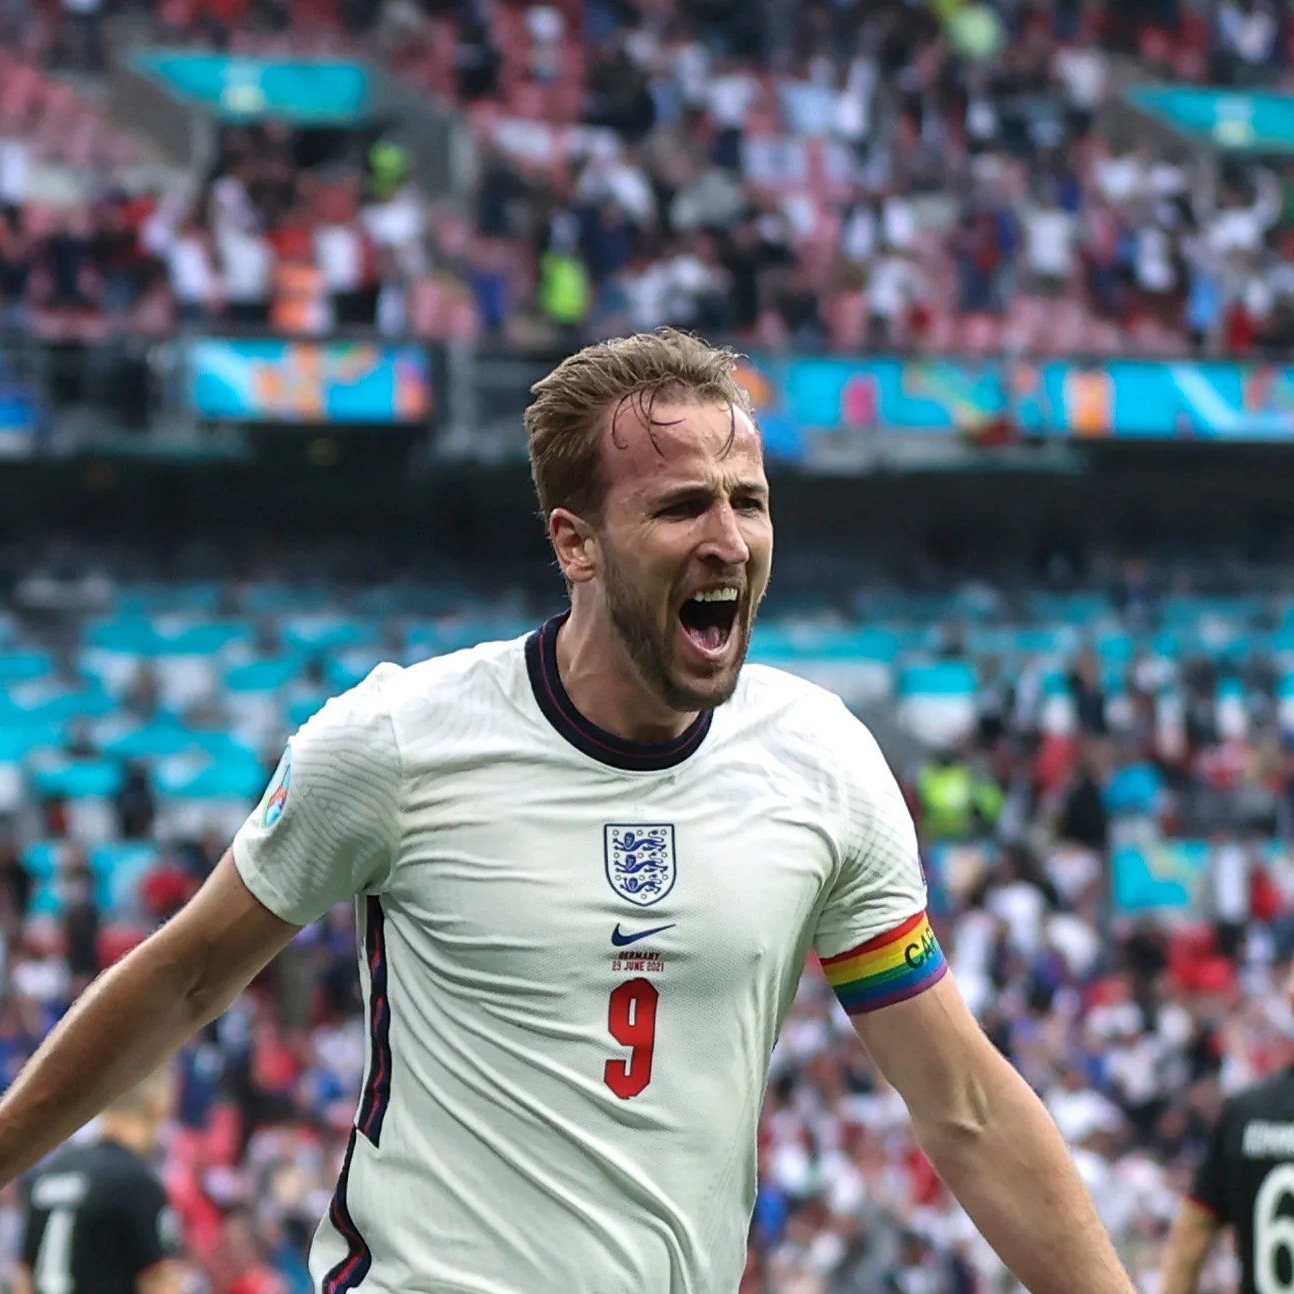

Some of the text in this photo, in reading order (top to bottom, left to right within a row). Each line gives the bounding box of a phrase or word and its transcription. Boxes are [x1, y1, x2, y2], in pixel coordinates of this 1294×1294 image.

[619, 951, 661, 960] GERMANY
[624, 961, 645, 972] JUNE
[646, 962, 665, 972] 2021
[604, 977, 660, 1100] 9
